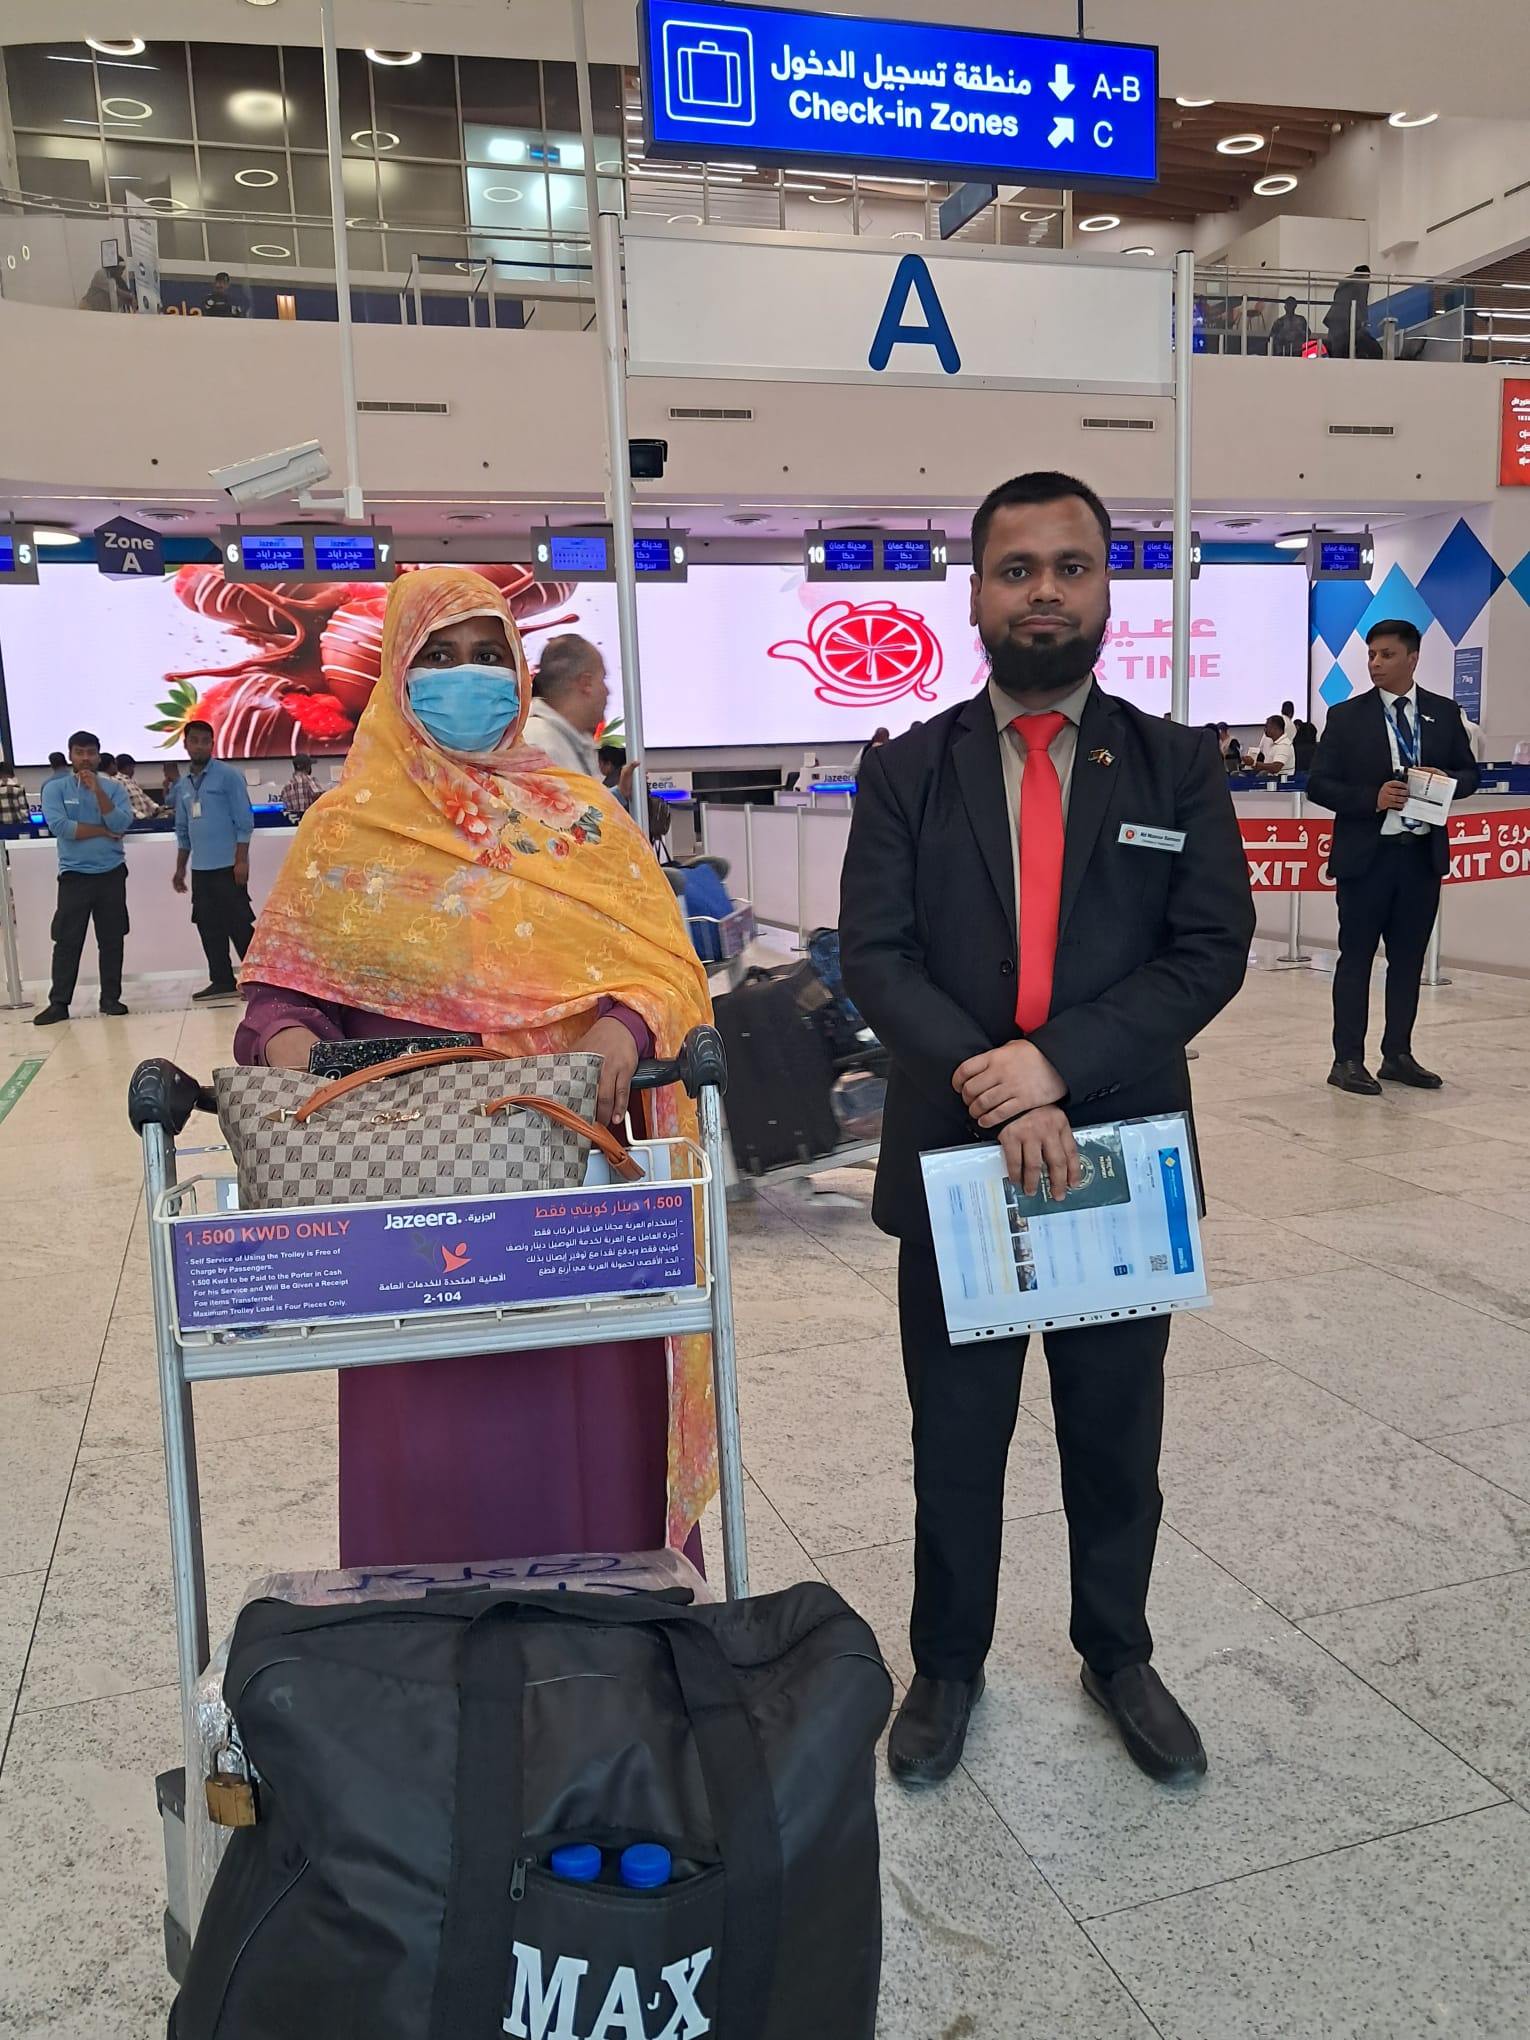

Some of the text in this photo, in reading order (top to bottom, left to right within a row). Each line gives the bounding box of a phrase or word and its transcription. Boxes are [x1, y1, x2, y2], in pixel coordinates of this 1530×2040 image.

[770, 44, 1032, 96] منطقة تسجيل الدخول
[1091, 72, 1142, 103] A-B
[788, 89, 1019, 137] Check-in Zones
[1093, 120, 1115, 149] C
[868, 253, 962, 375] A
[104, 532, 155, 550] Zone
[18, 544, 32, 564] 5
[122, 552, 143, 572] A
[226, 543, 239, 563] 6
[378, 544, 389, 562] 7
[537, 544, 548, 563] 8
[673, 546, 684, 564] 9
[808, 546, 825, 563] 10
[932, 546, 947, 563] 11
[1361, 548, 1374, 564] 14
[1247, 861, 1308, 886] XIT
[1441, 852, 1491, 880] XIT
[535, 1195, 683, 1219] 1.500 دينار كويتي فقط
[185, 1220, 350, 1246] 1.500 KWD ONLY
[206, 1256, 233, 1264] Service
[244, 1254, 265, 1262] Using
[280, 1250, 305, 1259] Trolley
[218, 1267, 227, 1275] by
[250, 1274, 266, 1282] Paid
[322, 1279, 348, 1287] Receipt
[423, 1291, 462, 1304] 2-104
[193, 1309, 228, 1317] Maximum
[230, 1307, 254, 1315] Trolley
[256, 1305, 274, 1313] Load
[303, 1301, 327, 1309] Pieces
[502, 1940, 713, 2040] MAX
